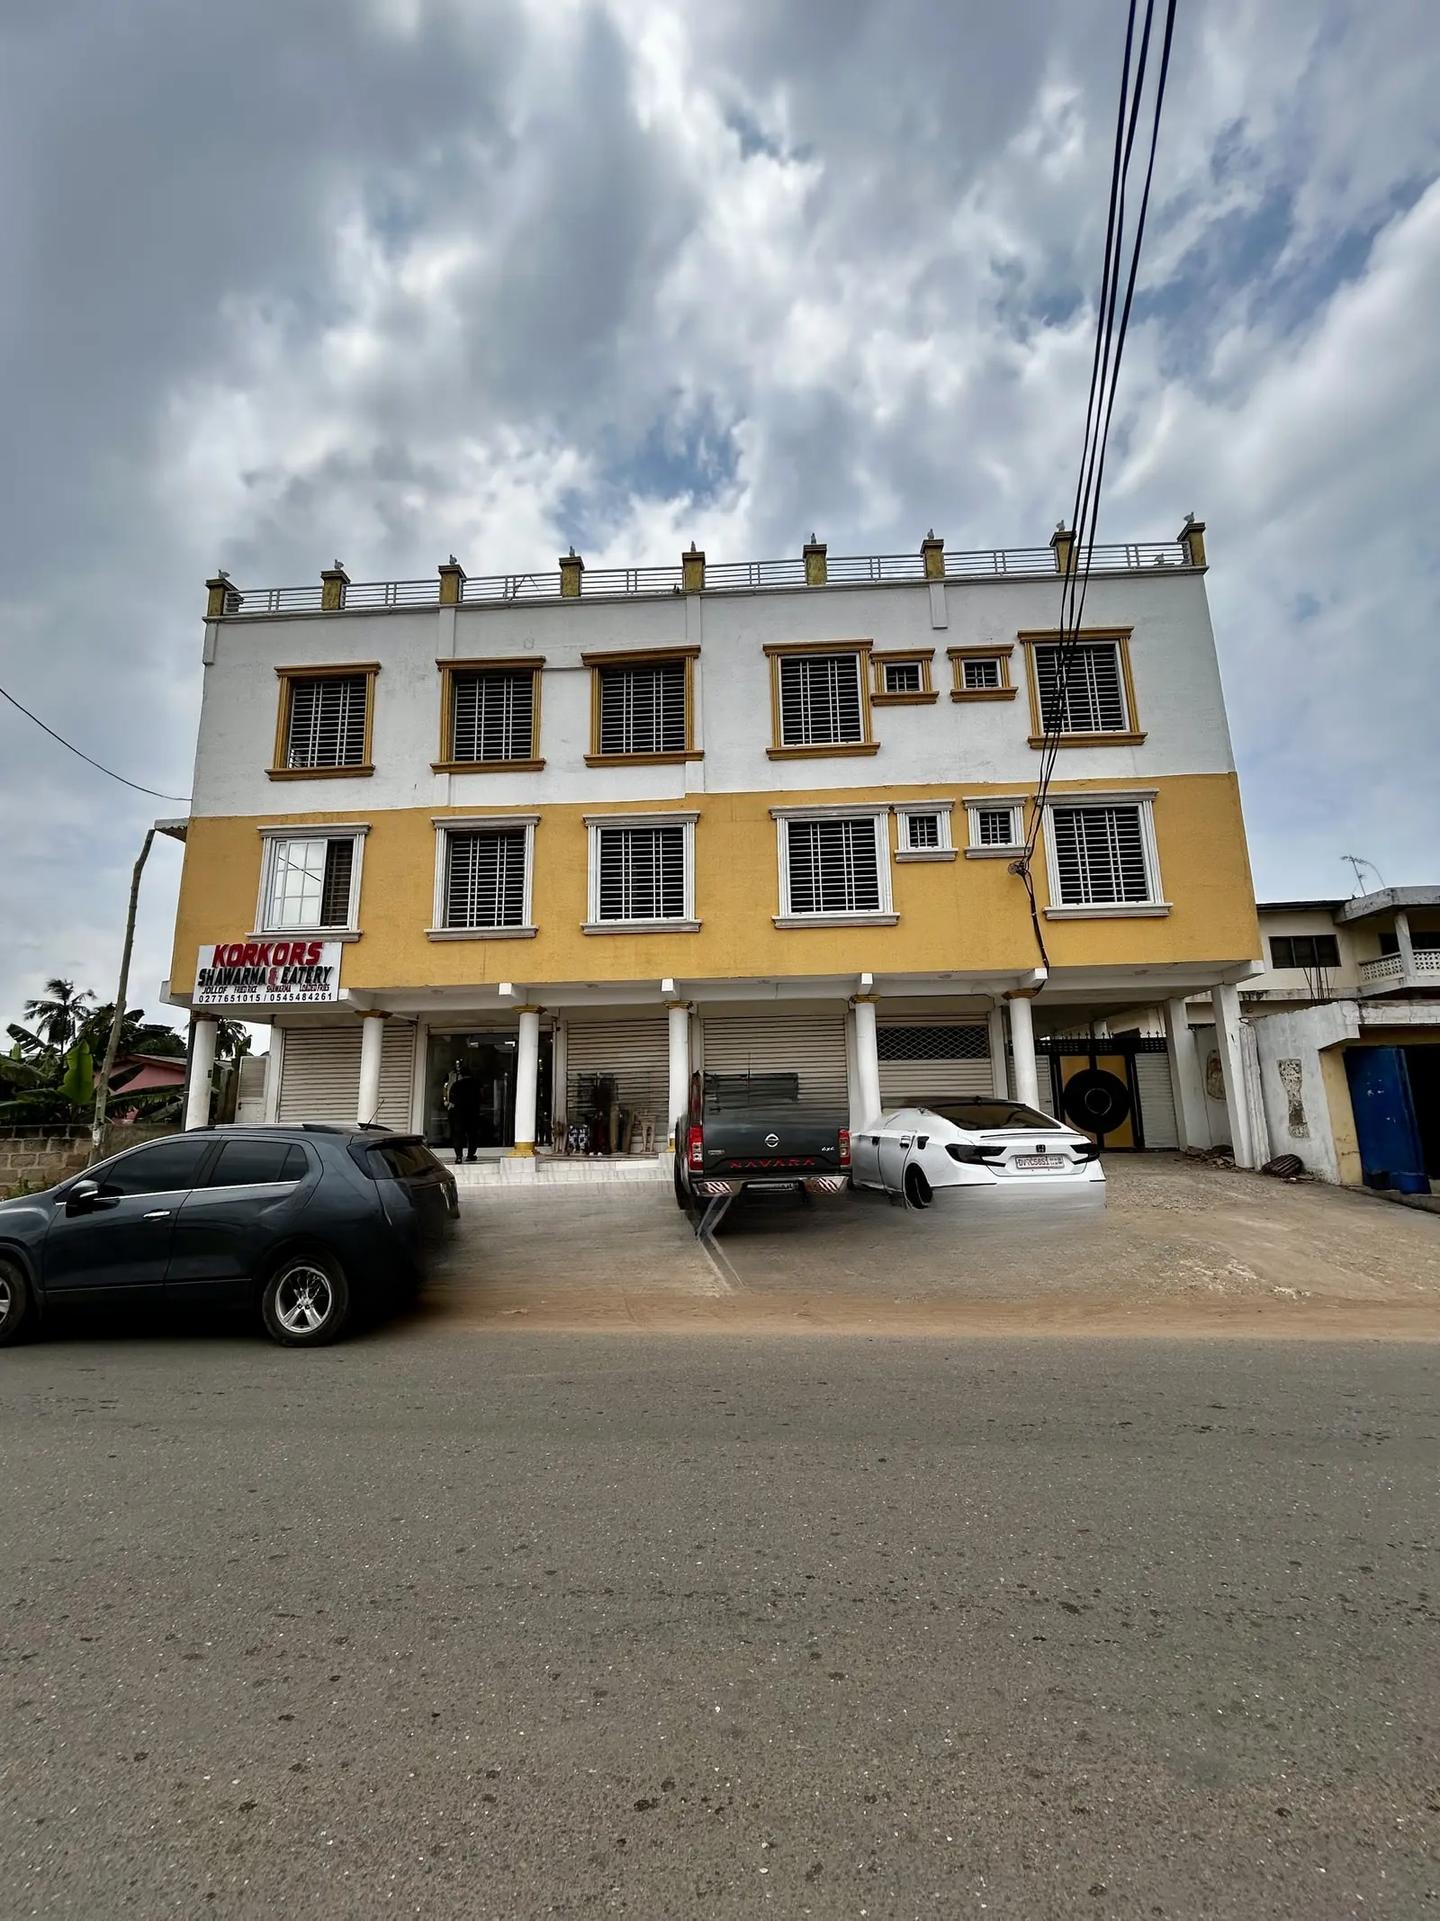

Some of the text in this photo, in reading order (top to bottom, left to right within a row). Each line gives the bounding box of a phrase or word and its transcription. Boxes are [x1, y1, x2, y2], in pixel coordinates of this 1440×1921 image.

[212, 942, 323, 967] KORKORS
[198, 966, 333, 985] SHAWARMA & EATERY
[201, 986, 228, 994] JOLLOF
[198, 994, 261, 1003] 0277651015
[269, 992, 332, 1001] 0545484261
[730, 1159, 815, 1168] NAVARA
